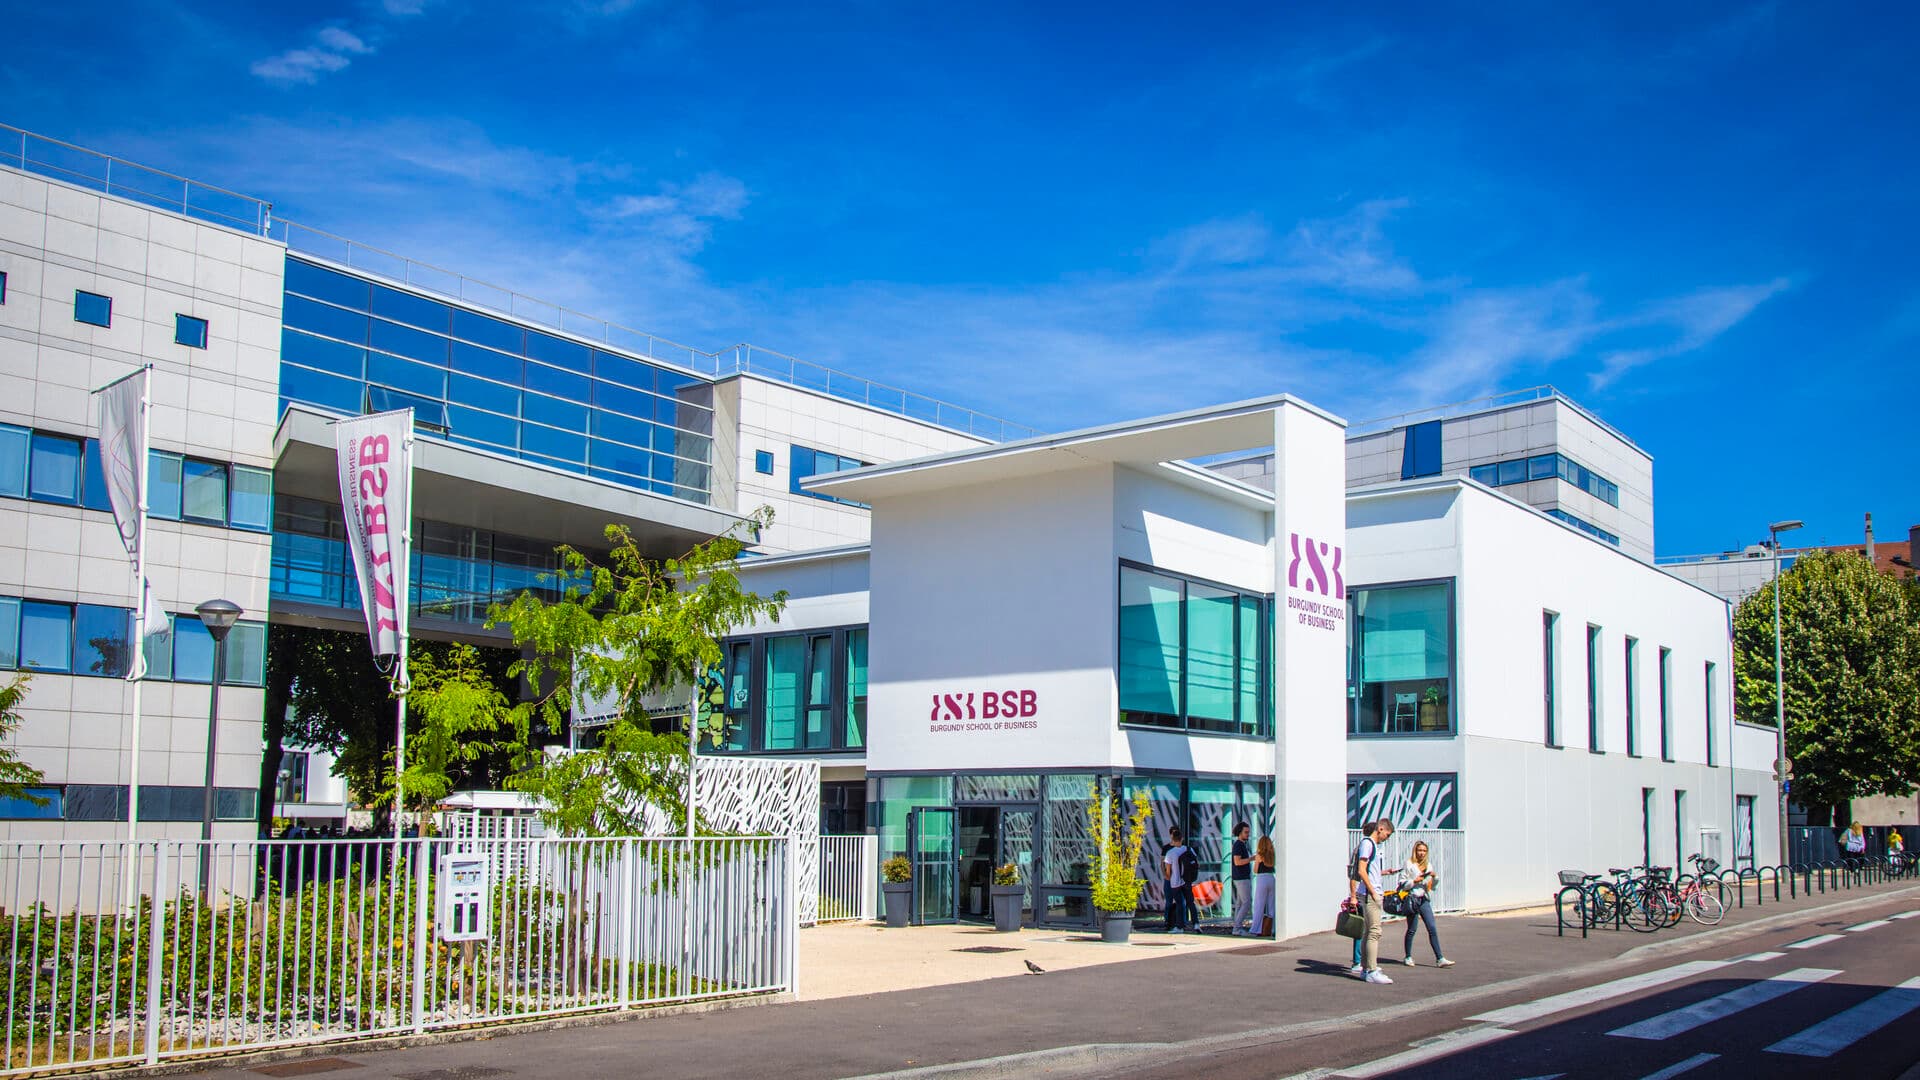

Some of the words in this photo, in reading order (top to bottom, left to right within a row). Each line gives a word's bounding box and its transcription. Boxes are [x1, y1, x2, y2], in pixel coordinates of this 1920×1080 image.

[1288, 596, 1321, 614] BURGUNDY
[1322, 604, 1344, 620] SCHOOL
[1299, 613, 1307, 624] OF
[1308, 615, 1335, 631] BUSINESS
[982, 690, 1037, 719] BSB
[930, 724, 965, 732] BURGUNDY
[966, 722, 992, 731] SCHOOL
[994, 722, 1003, 731] OF
[1004, 721, 1037, 729] BUSINESS
